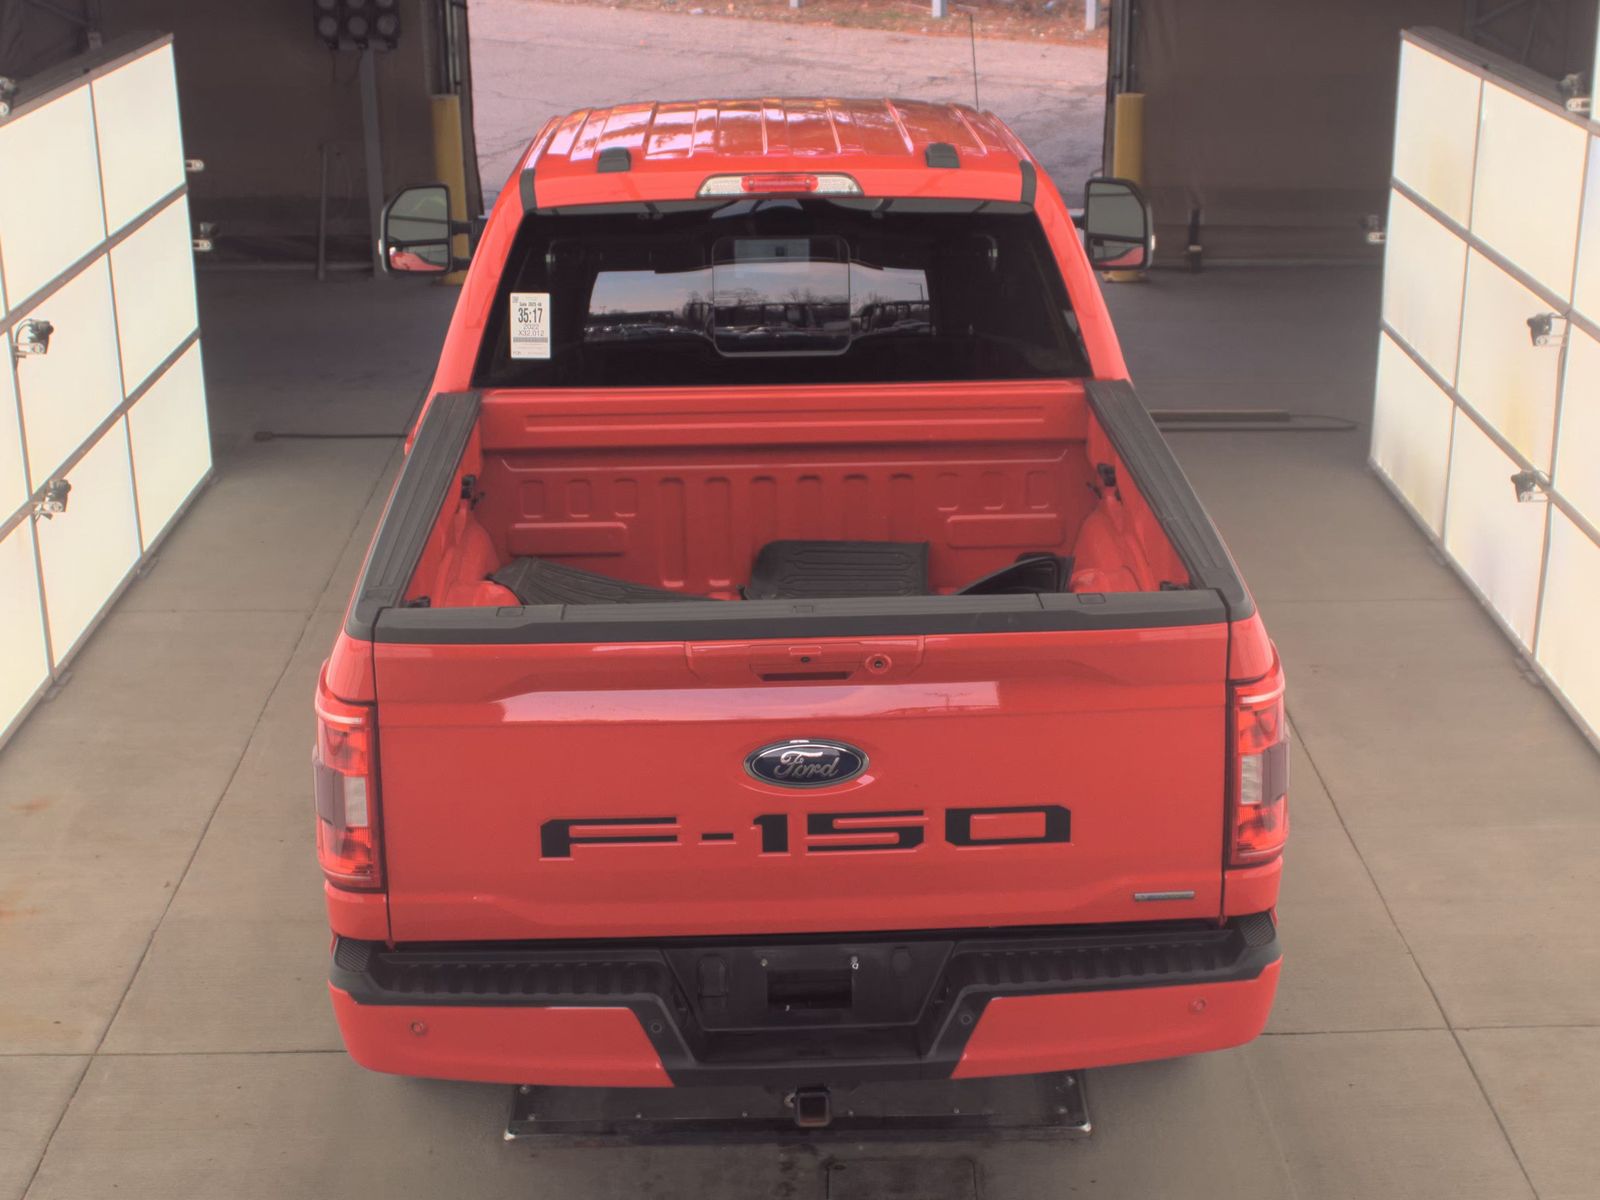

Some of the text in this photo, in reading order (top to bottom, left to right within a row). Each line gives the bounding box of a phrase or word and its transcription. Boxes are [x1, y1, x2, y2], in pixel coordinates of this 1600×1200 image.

[518, 308, 543, 323] 35:17
[773, 750, 840, 778] Ford
[540, 804, 1072, 859] F-150
